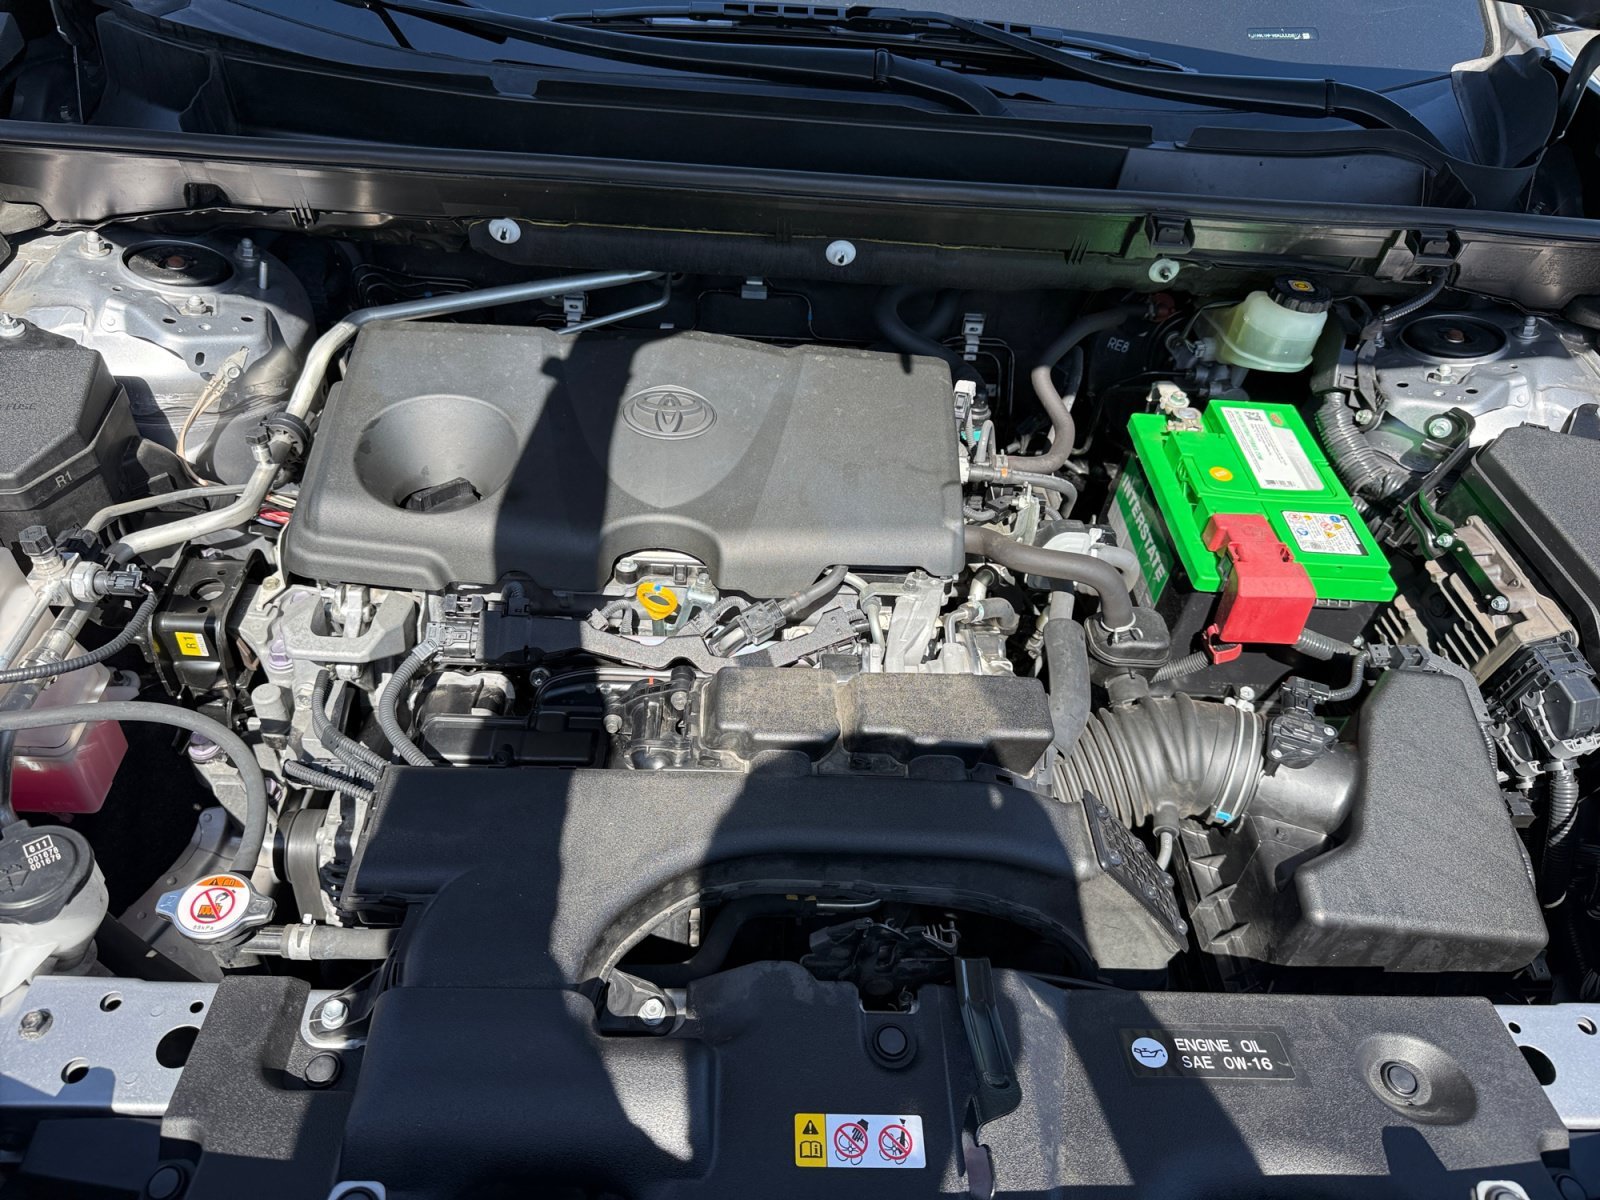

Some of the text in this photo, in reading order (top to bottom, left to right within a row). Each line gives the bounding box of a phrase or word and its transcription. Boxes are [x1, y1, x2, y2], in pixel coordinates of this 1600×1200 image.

[54, 470, 73, 488] R1
[1121, 474, 1166, 583] INTERSTATE
[1174, 1038, 1268, 1053] ENGINE OIL
[1181, 1055, 1274, 1071] SAE 0W-16
